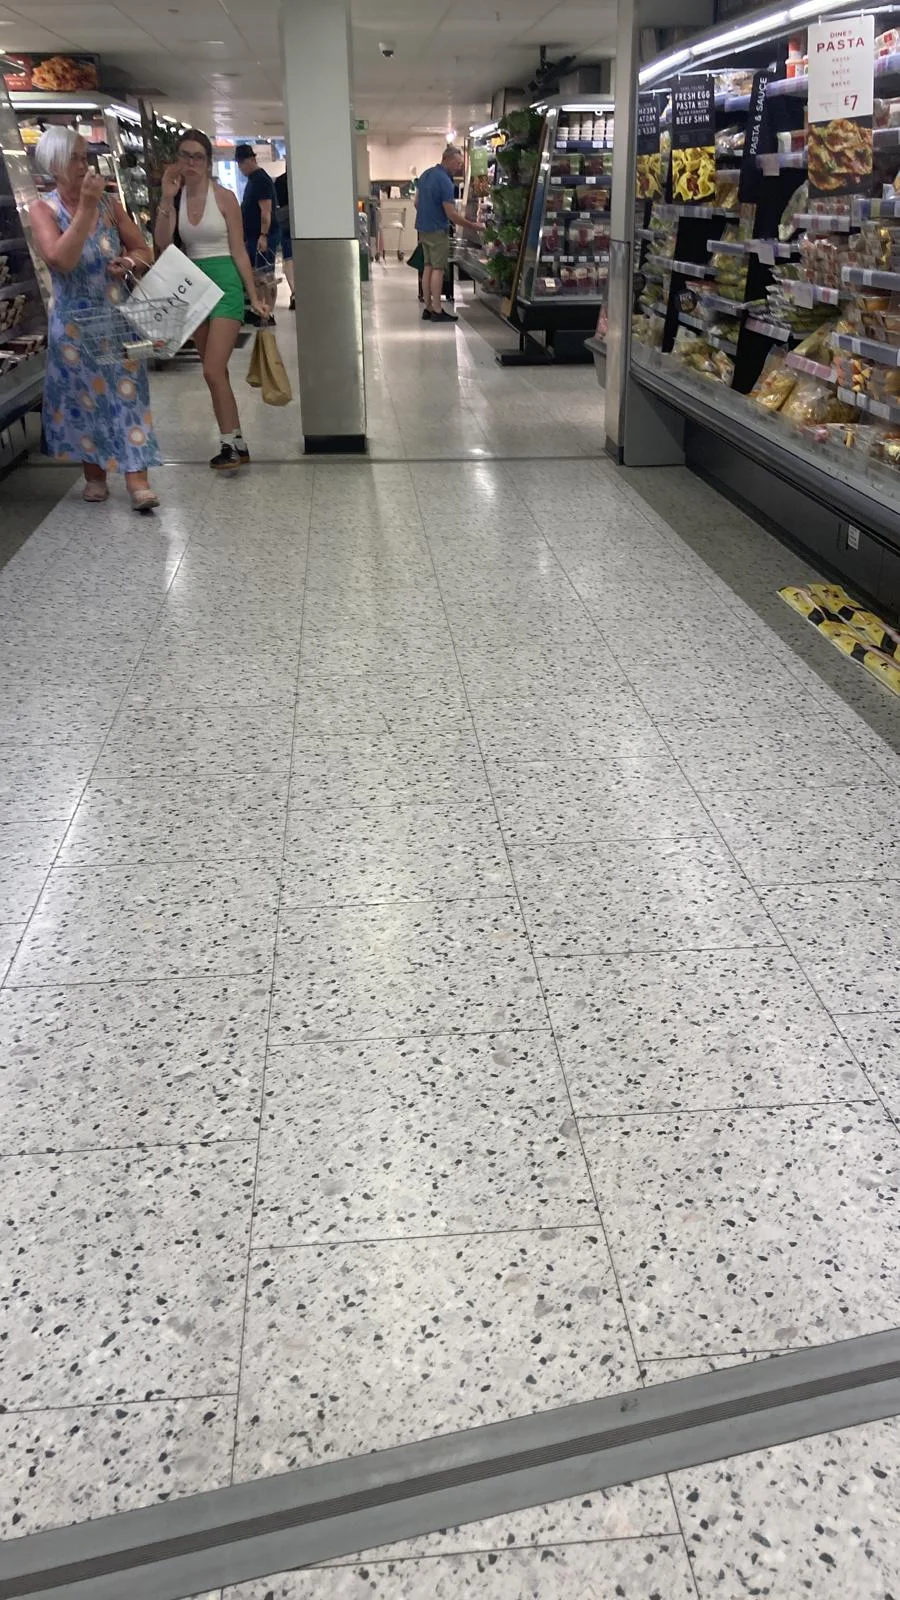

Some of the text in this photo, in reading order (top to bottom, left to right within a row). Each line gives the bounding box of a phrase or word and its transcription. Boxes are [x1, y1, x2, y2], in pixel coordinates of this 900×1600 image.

[816, 37, 865, 53] PASTA
[675, 90, 711, 101] FRESH EGG
[676, 101, 696, 111] PASTA
[844, 94, 858, 111] £7
[676, 114, 710, 125] BEEF SHIN
[749, 77, 768, 155] PASTA & SAUCE
